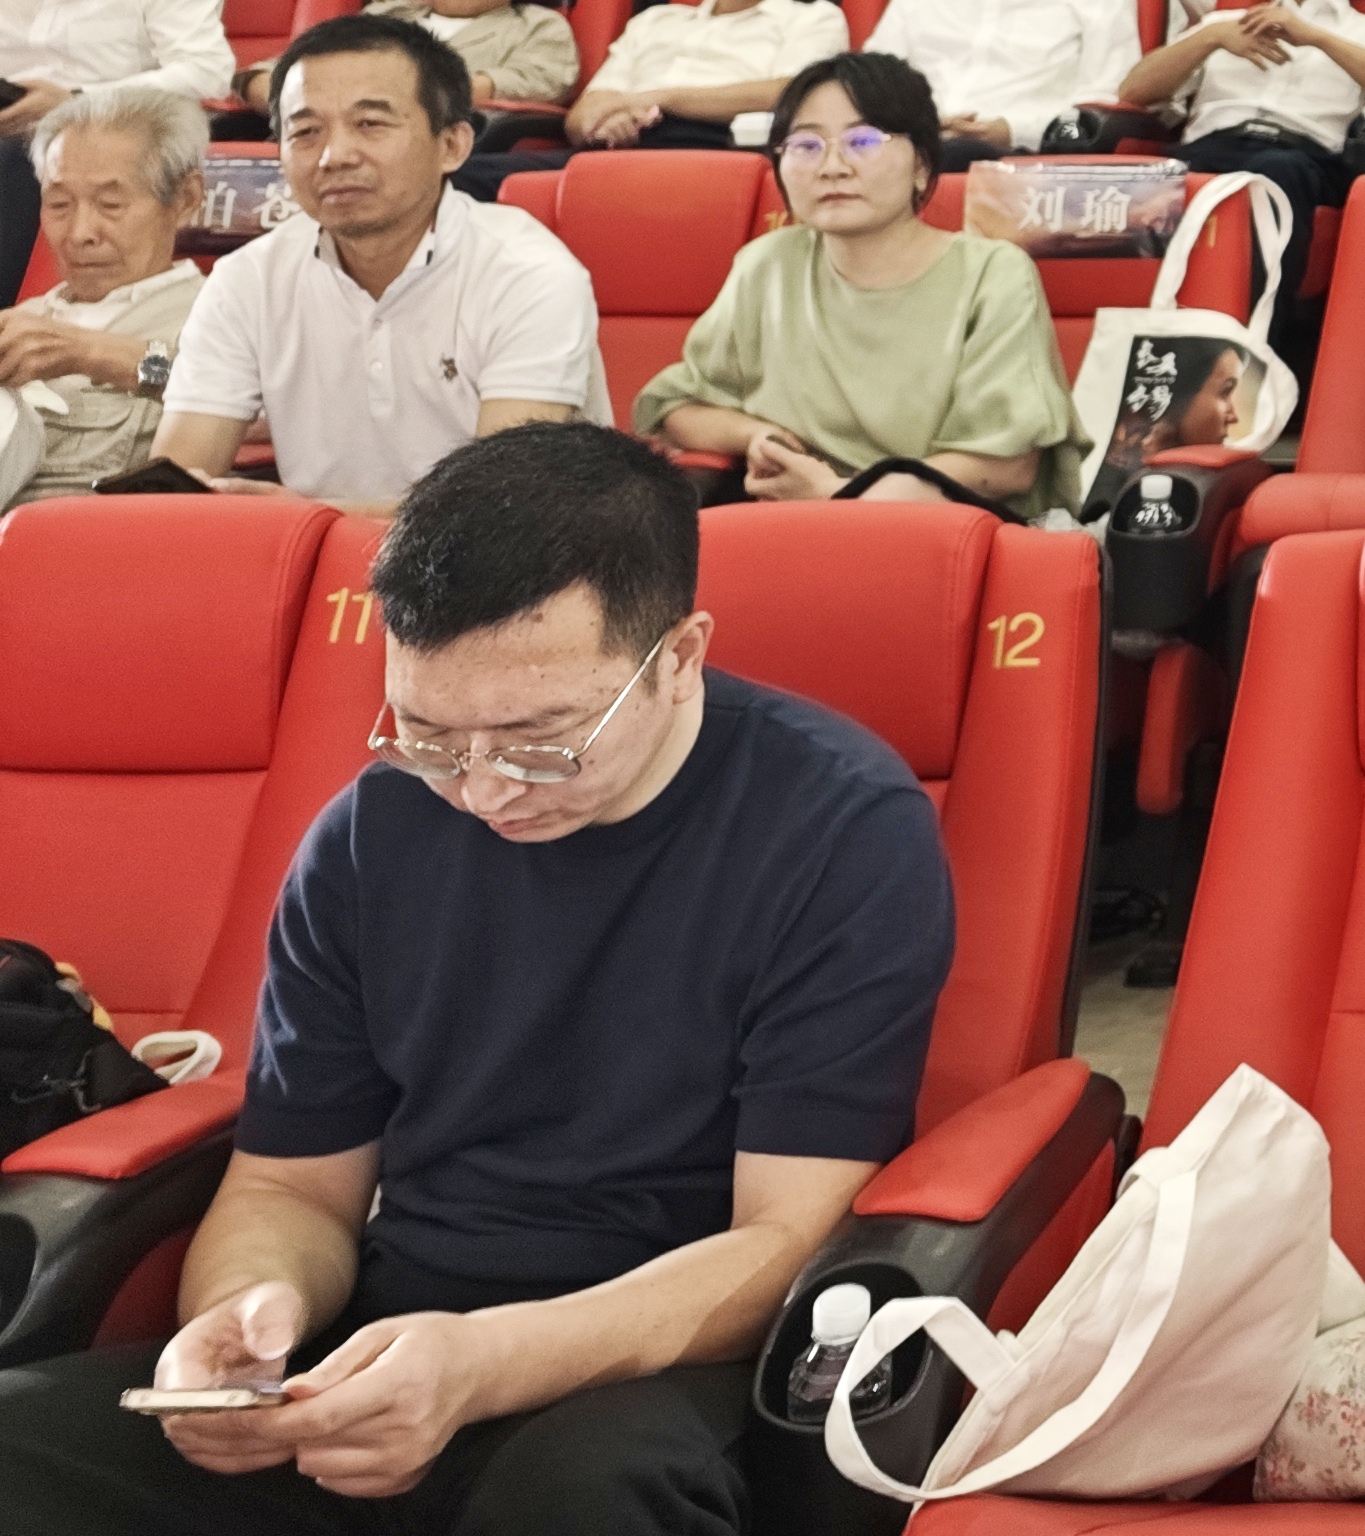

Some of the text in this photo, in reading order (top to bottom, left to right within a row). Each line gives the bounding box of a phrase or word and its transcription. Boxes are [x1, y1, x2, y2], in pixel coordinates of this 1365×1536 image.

[1018, 185, 1132, 234] 刘瑜
[326, 586, 374, 644] 11
[987, 611, 1046, 670] 12
